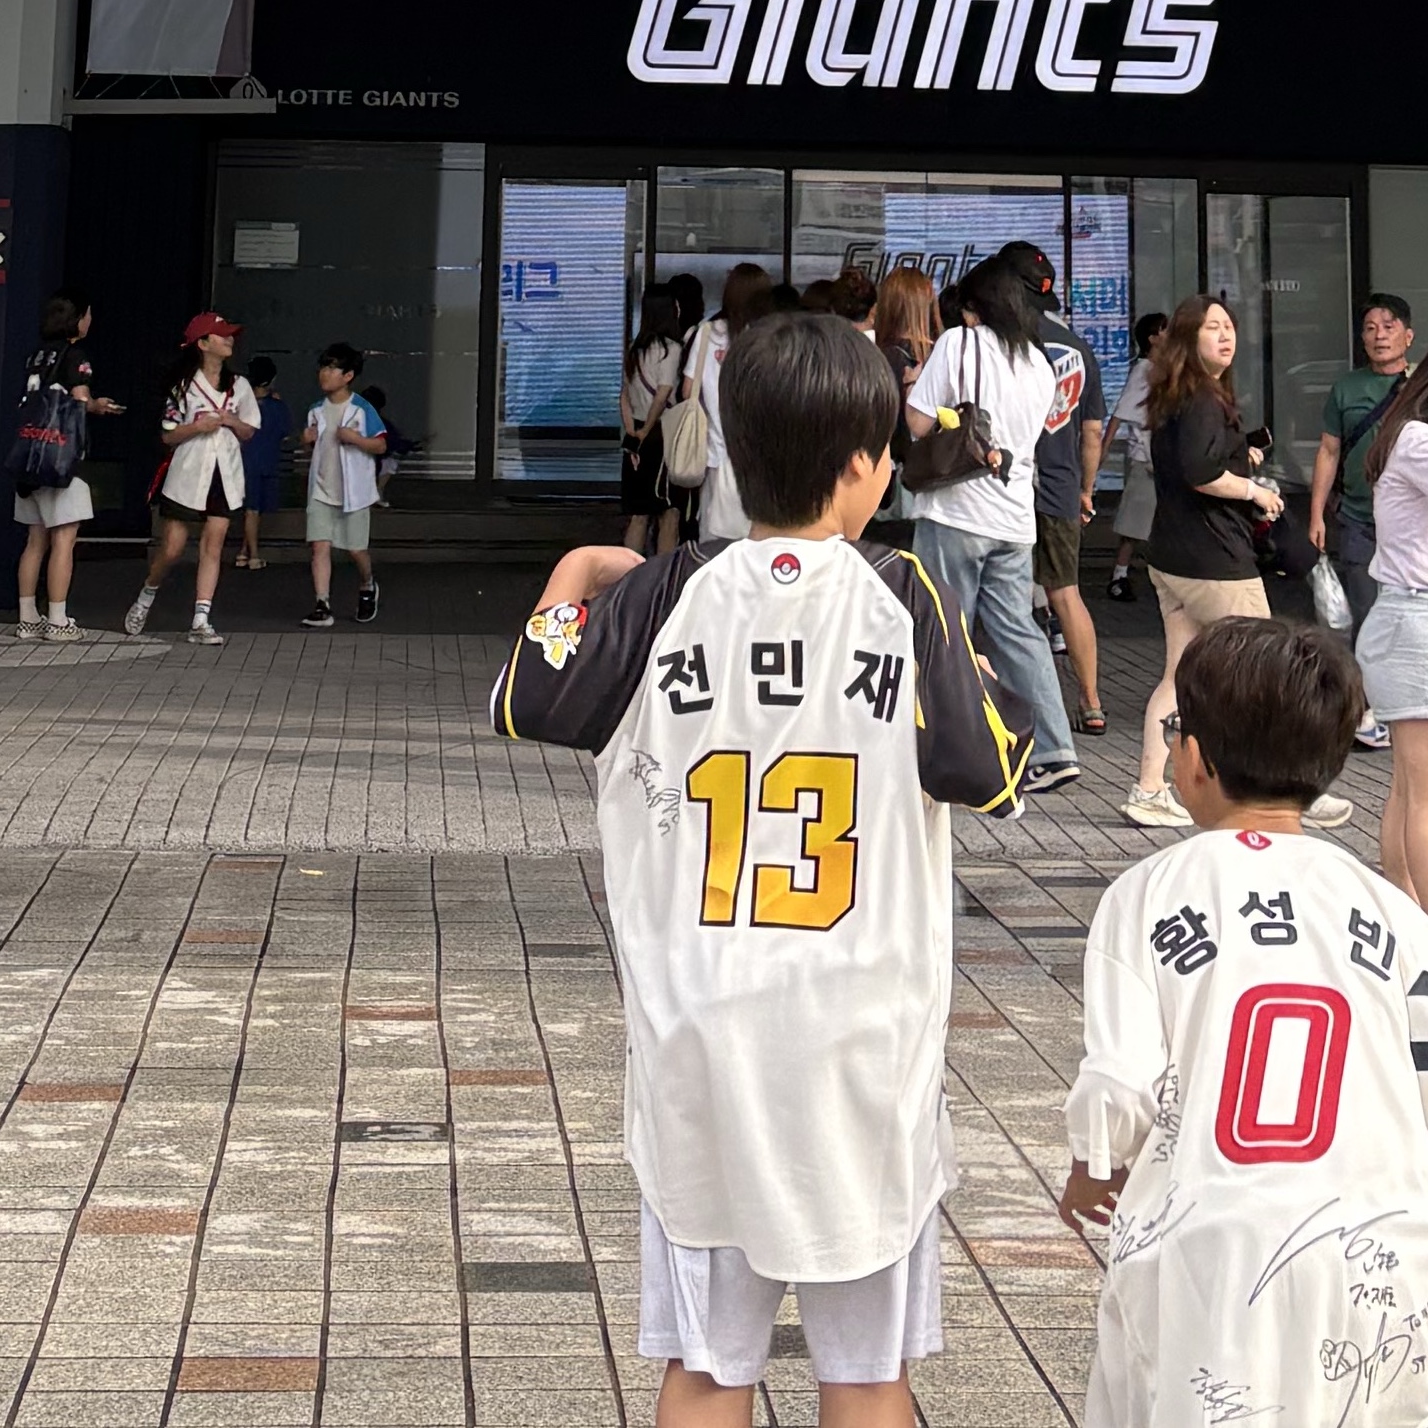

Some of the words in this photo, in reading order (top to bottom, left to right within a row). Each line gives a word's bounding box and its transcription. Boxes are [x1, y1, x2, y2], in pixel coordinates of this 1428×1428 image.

[276, 87, 353, 107] LOTTE
[361, 88, 461, 110] GIANTS
[685, 749, 860, 933] 13
[1214, 982, 1353, 1166] 0
